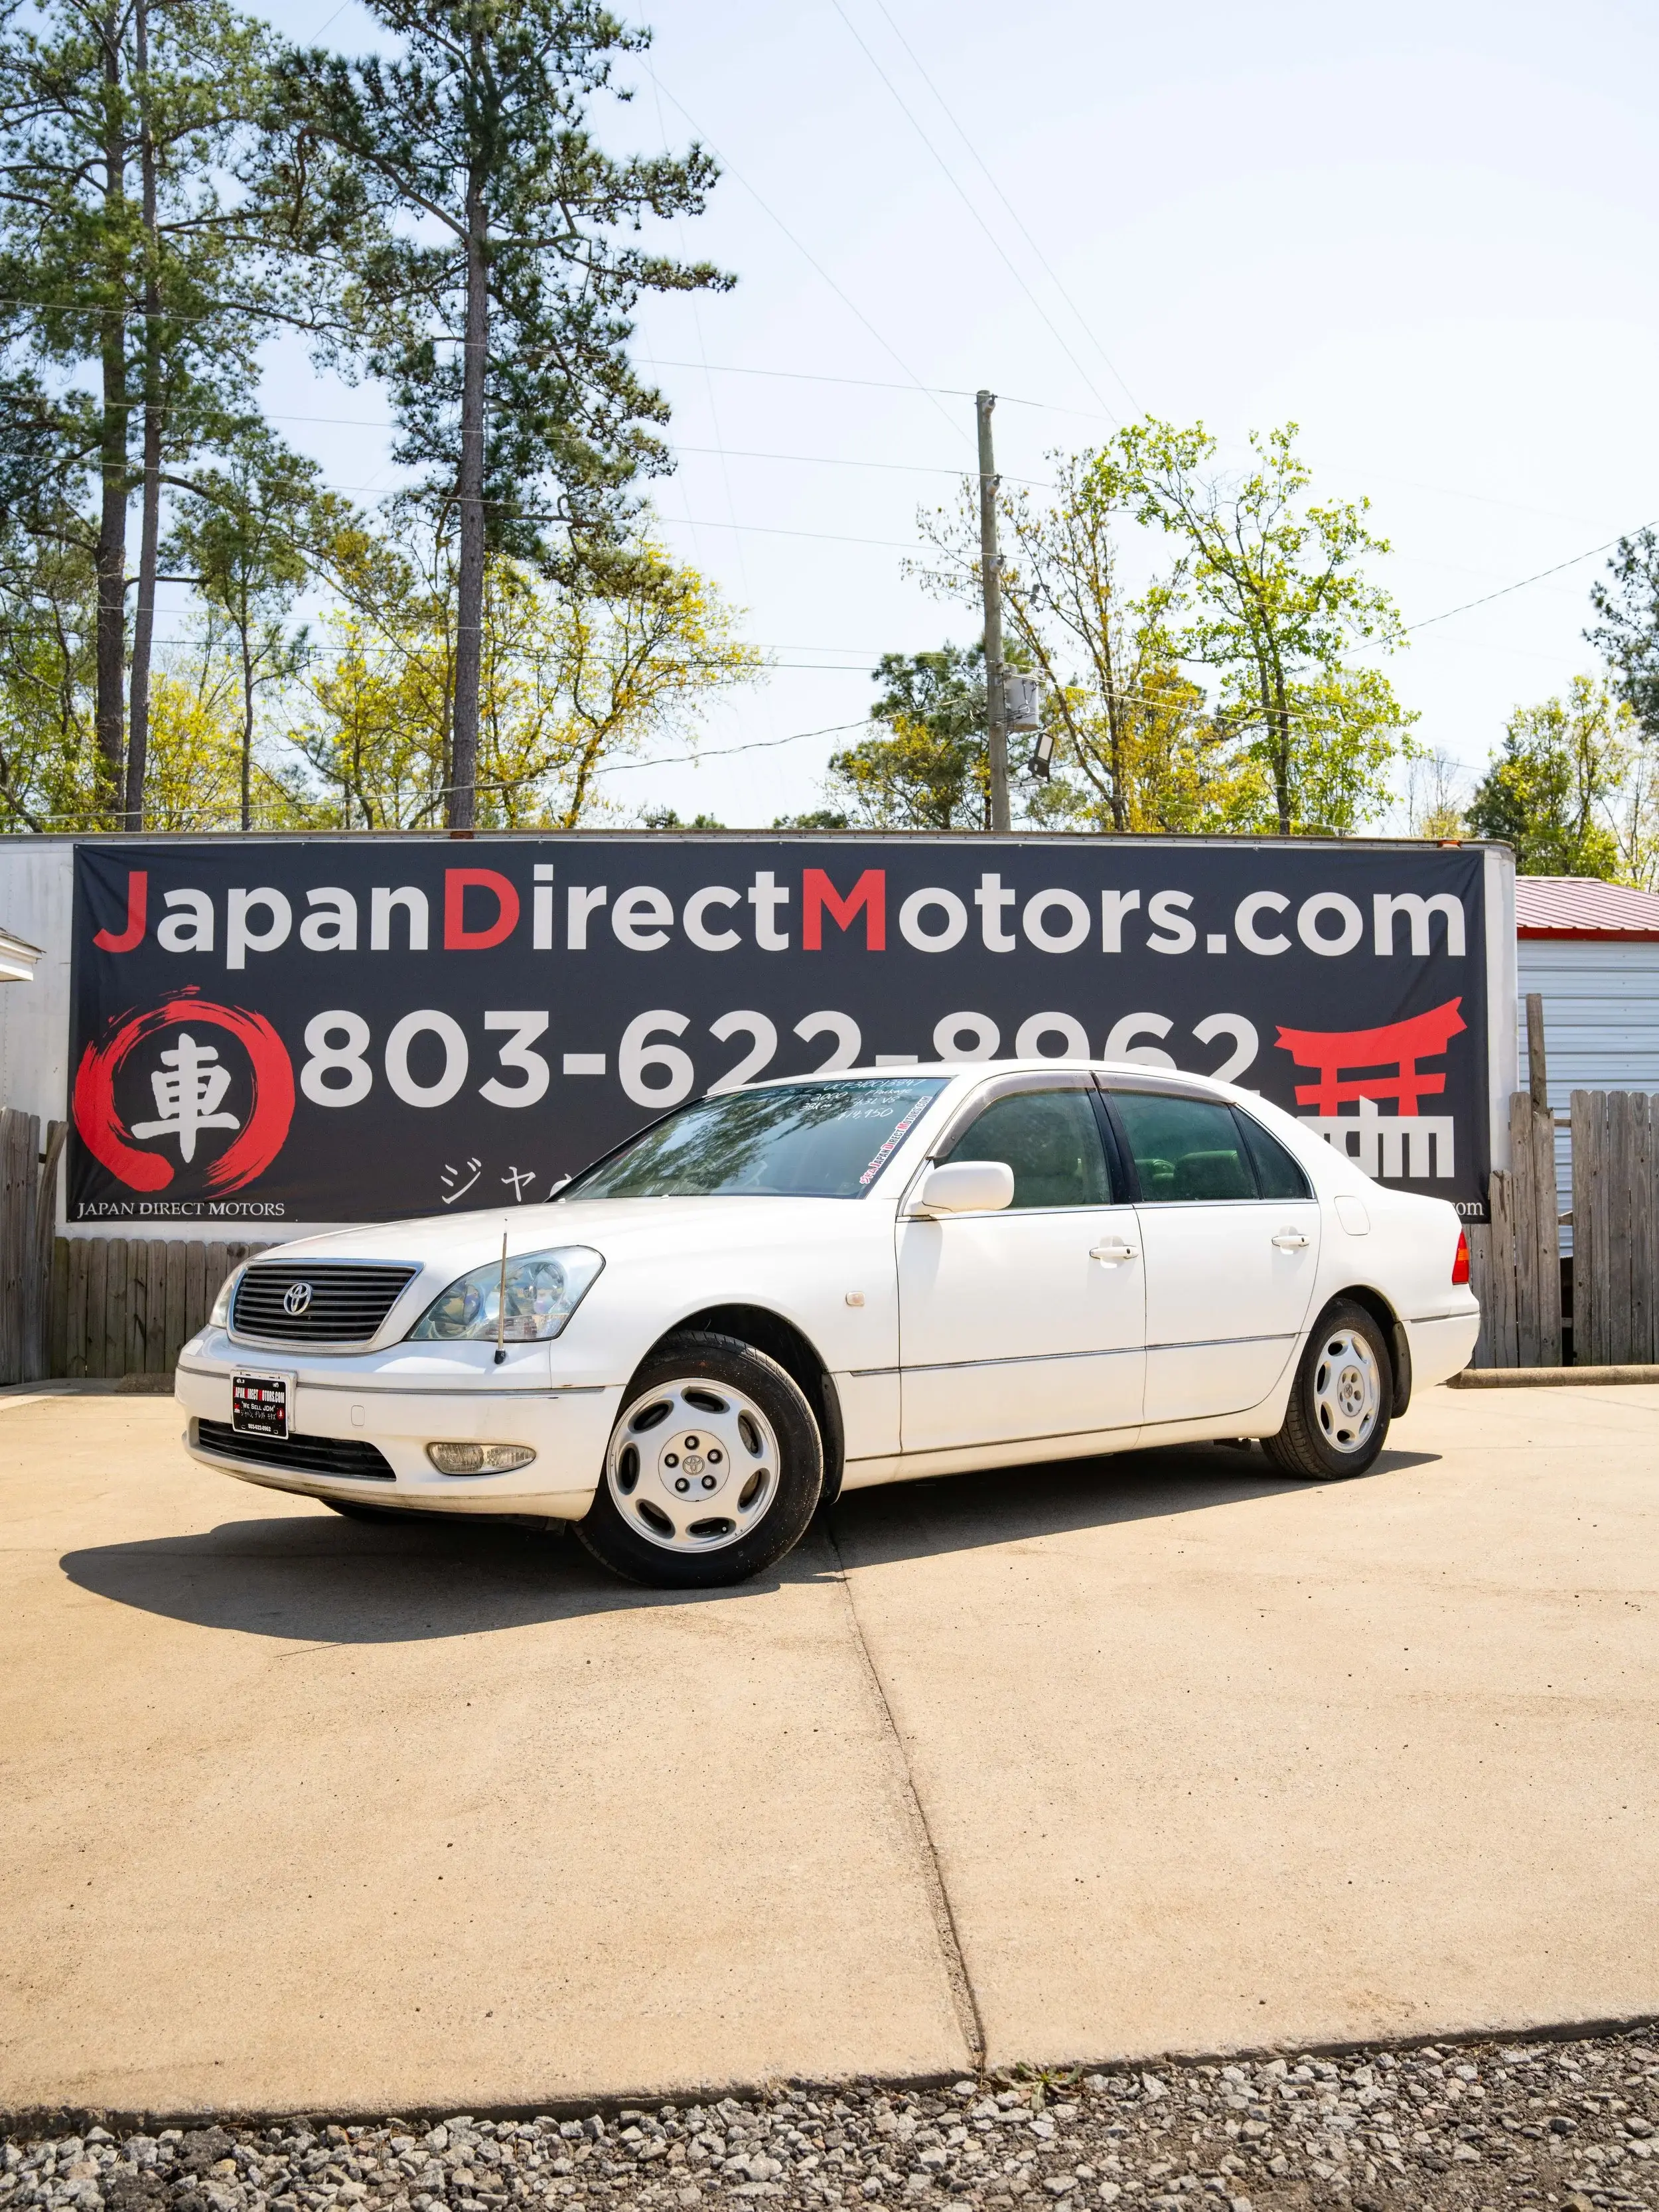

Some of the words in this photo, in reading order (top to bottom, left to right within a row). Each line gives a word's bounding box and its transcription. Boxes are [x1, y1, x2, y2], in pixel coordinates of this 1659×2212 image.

[94, 863, 1466, 970] JapanDirectMotors.com
[131, 1033, 240, 1163] 車
[77, 1202, 135, 1218] JAPAN
[139, 1202, 202, 1215] DIRECT
[208, 1203, 285, 1216] MOTORS
